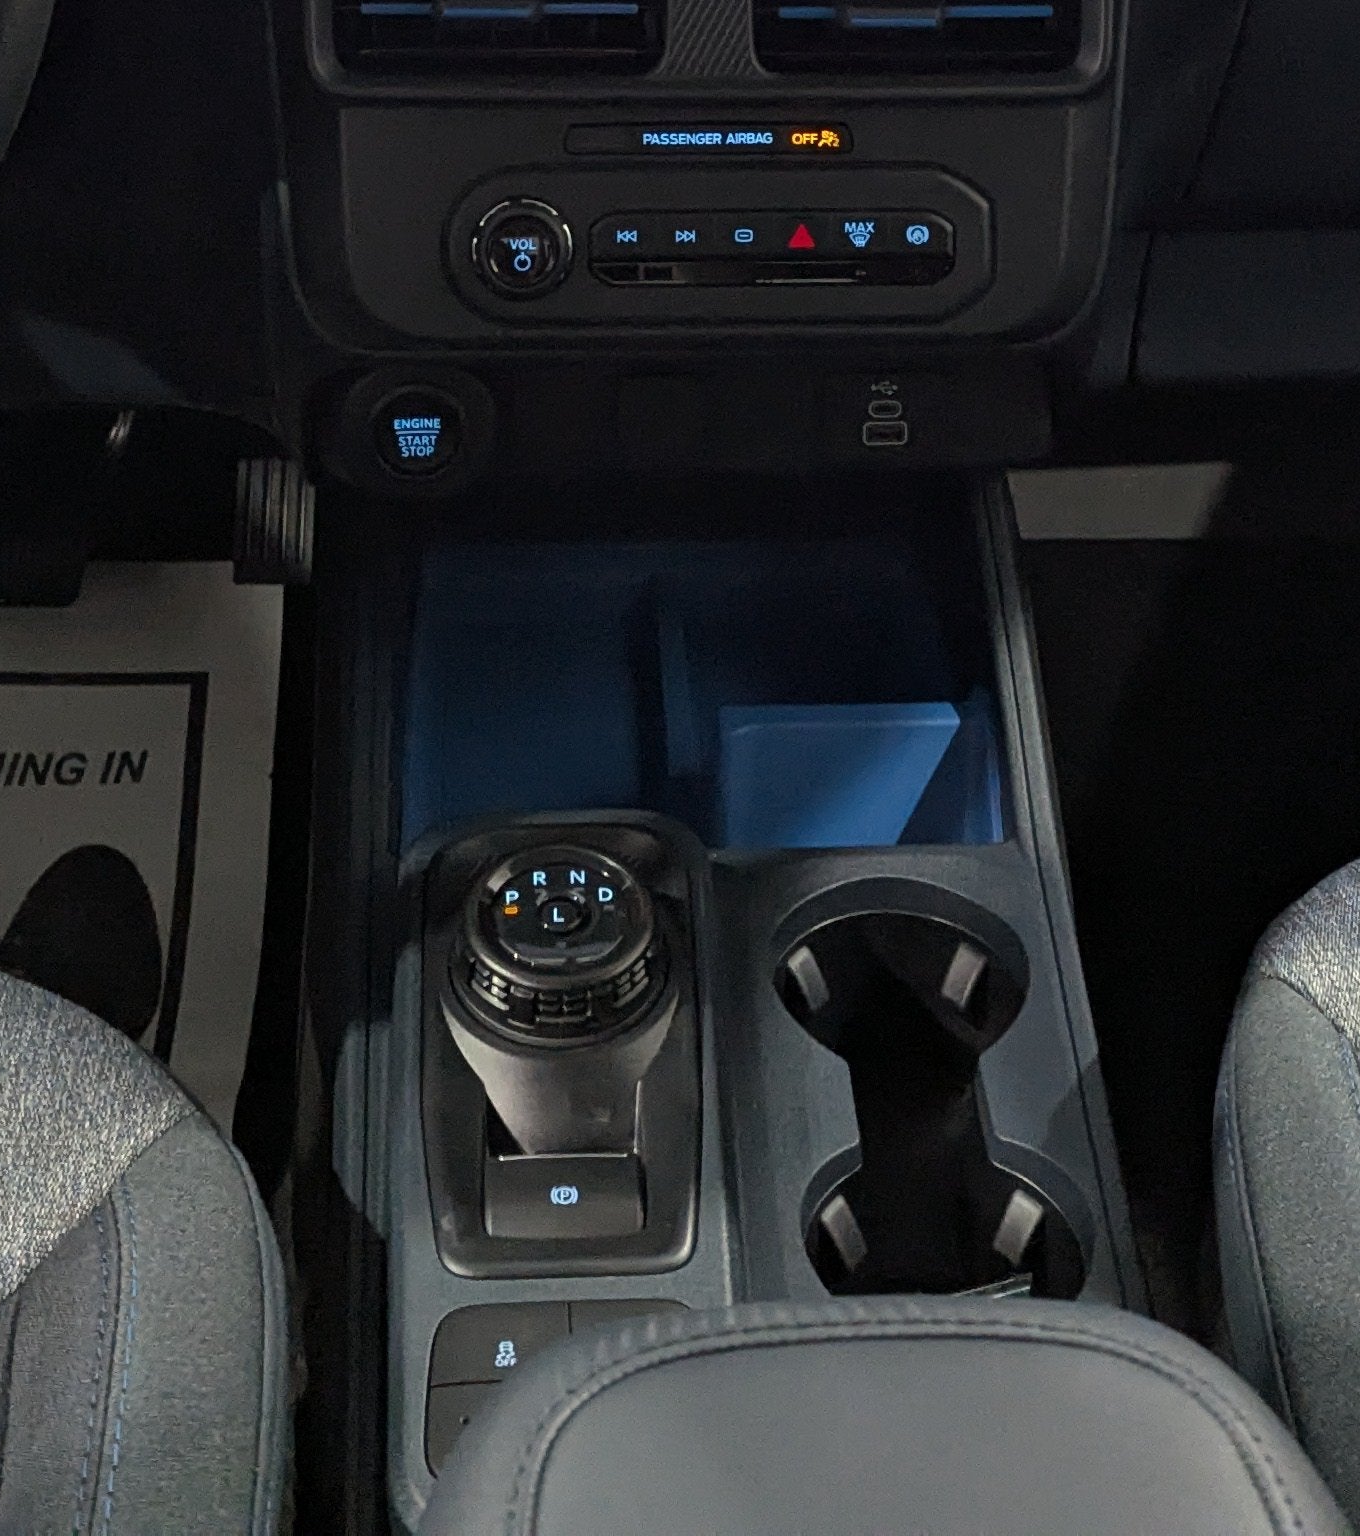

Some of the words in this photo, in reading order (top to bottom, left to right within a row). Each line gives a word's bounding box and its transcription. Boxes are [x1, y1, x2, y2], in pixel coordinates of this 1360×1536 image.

[643, 133, 722, 145] PASSENGER
[726, 133, 773, 145] AIRBAG
[791, 133, 818, 145] OFF
[844, 222, 874, 234] MAX
[510, 239, 536, 251] VOL
[393, 418, 441, 429] ENGINE
[398, 435, 437, 446] START
[401, 446, 434, 457] STOP
[99, 748, 149, 785] IN
[533, 871, 547, 886] R
[569, 871, 586, 885] N
[505, 891, 519, 905] P
[598, 887, 613, 902] D
[553, 907, 564, 923] L
